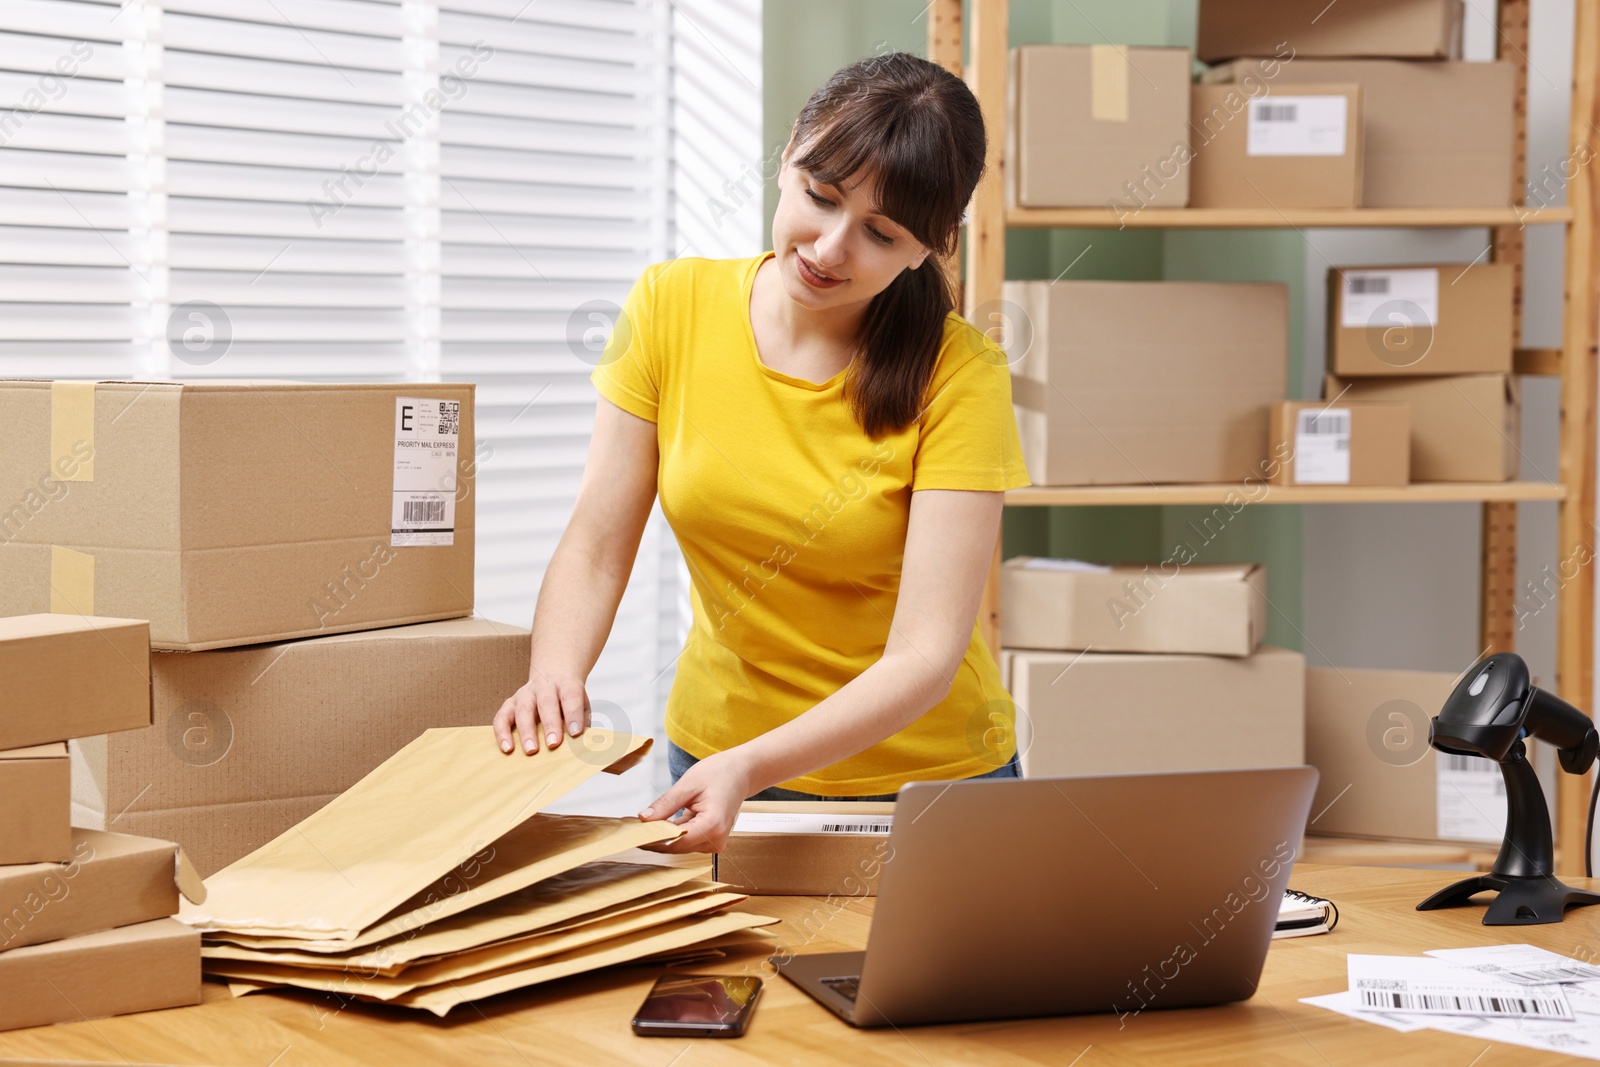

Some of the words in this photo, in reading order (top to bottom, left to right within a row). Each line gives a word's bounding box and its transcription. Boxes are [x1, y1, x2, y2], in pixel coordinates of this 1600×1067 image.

[402, 405, 413, 431] E
[397, 440, 420, 449] PRIORITY
[421, 441, 432, 449] MAIL
[433, 441, 456, 449] EXPRESS
